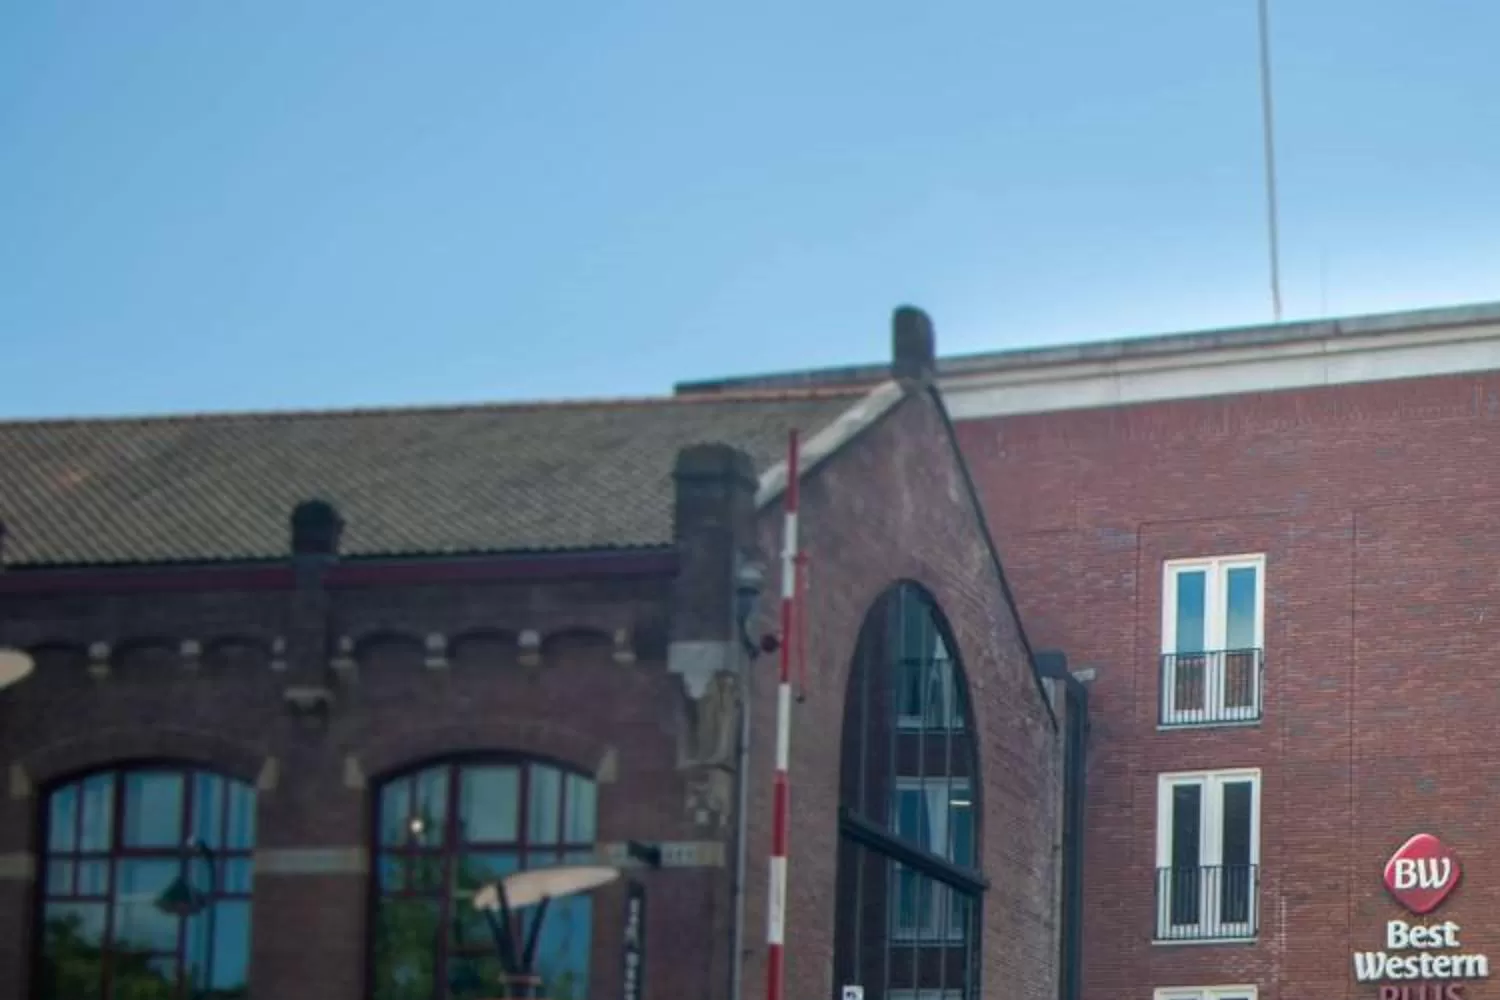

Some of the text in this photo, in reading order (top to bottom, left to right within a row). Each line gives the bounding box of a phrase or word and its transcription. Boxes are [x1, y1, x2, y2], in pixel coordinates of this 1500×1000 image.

[1394, 857, 1450, 889] BW
[1387, 920, 1460, 948] Best
[1354, 952, 1488, 981] Western
